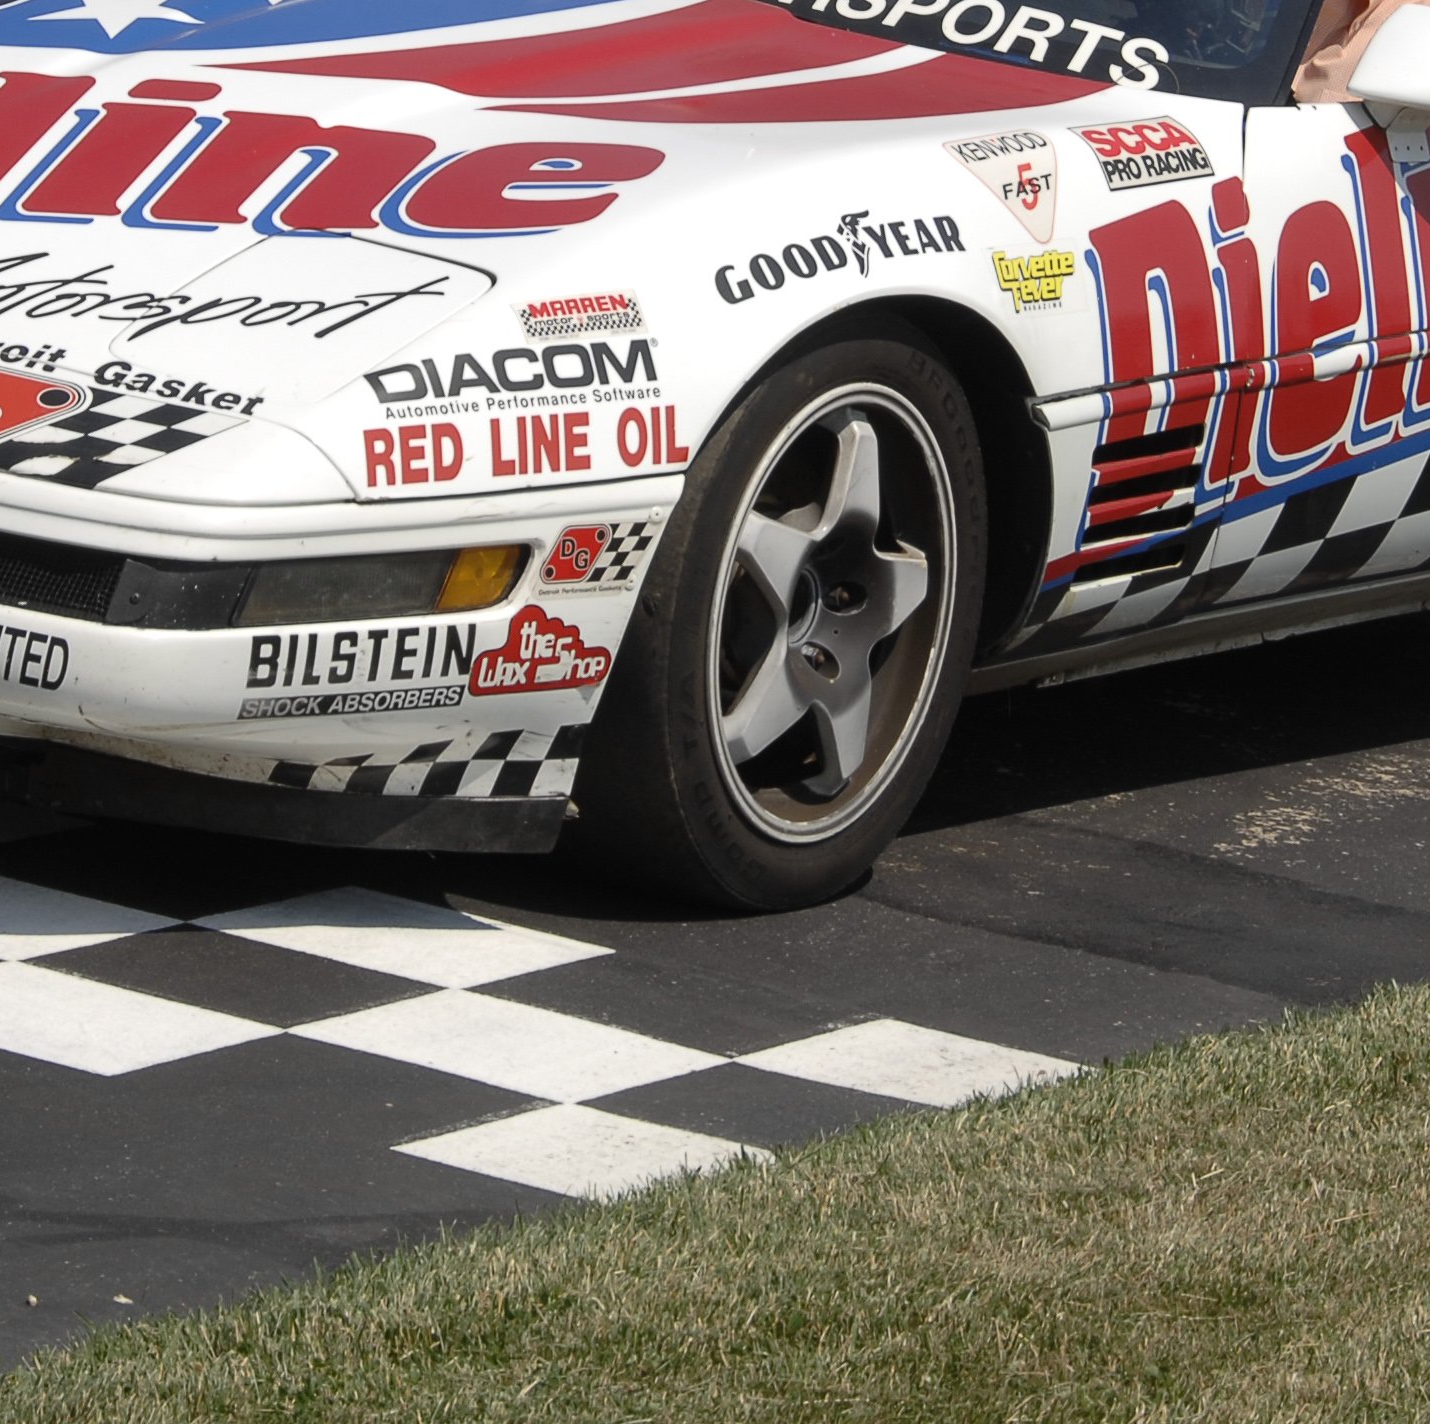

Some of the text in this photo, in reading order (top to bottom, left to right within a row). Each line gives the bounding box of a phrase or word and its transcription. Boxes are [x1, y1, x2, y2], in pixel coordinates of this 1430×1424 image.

[950, 131, 1048, 164] KENWOOD
[1080, 121, 1198, 159] SCCA
[1102, 147, 1211, 183] PRO RACING
[1002, 173, 1053, 200] FAST
[714, 214, 967, 305] GOODYEAR
[992, 250, 1075, 284] Corvette
[528, 293, 630, 319] MARREN
[1007, 276, 1064, 313] Fever
[534, 310, 631, 327] motor sports
[94, 359, 266, 418] Gasket
[385, 384, 662, 420] Automotive Performance Software
[363, 404, 690, 488] RED LINE OIL
[245, 624, 477, 691] BILSTEIN
[520, 621, 556, 659] the
[477, 657, 531, 688] Wax
[241, 686, 463, 720] SHOCK ABSORBERS
